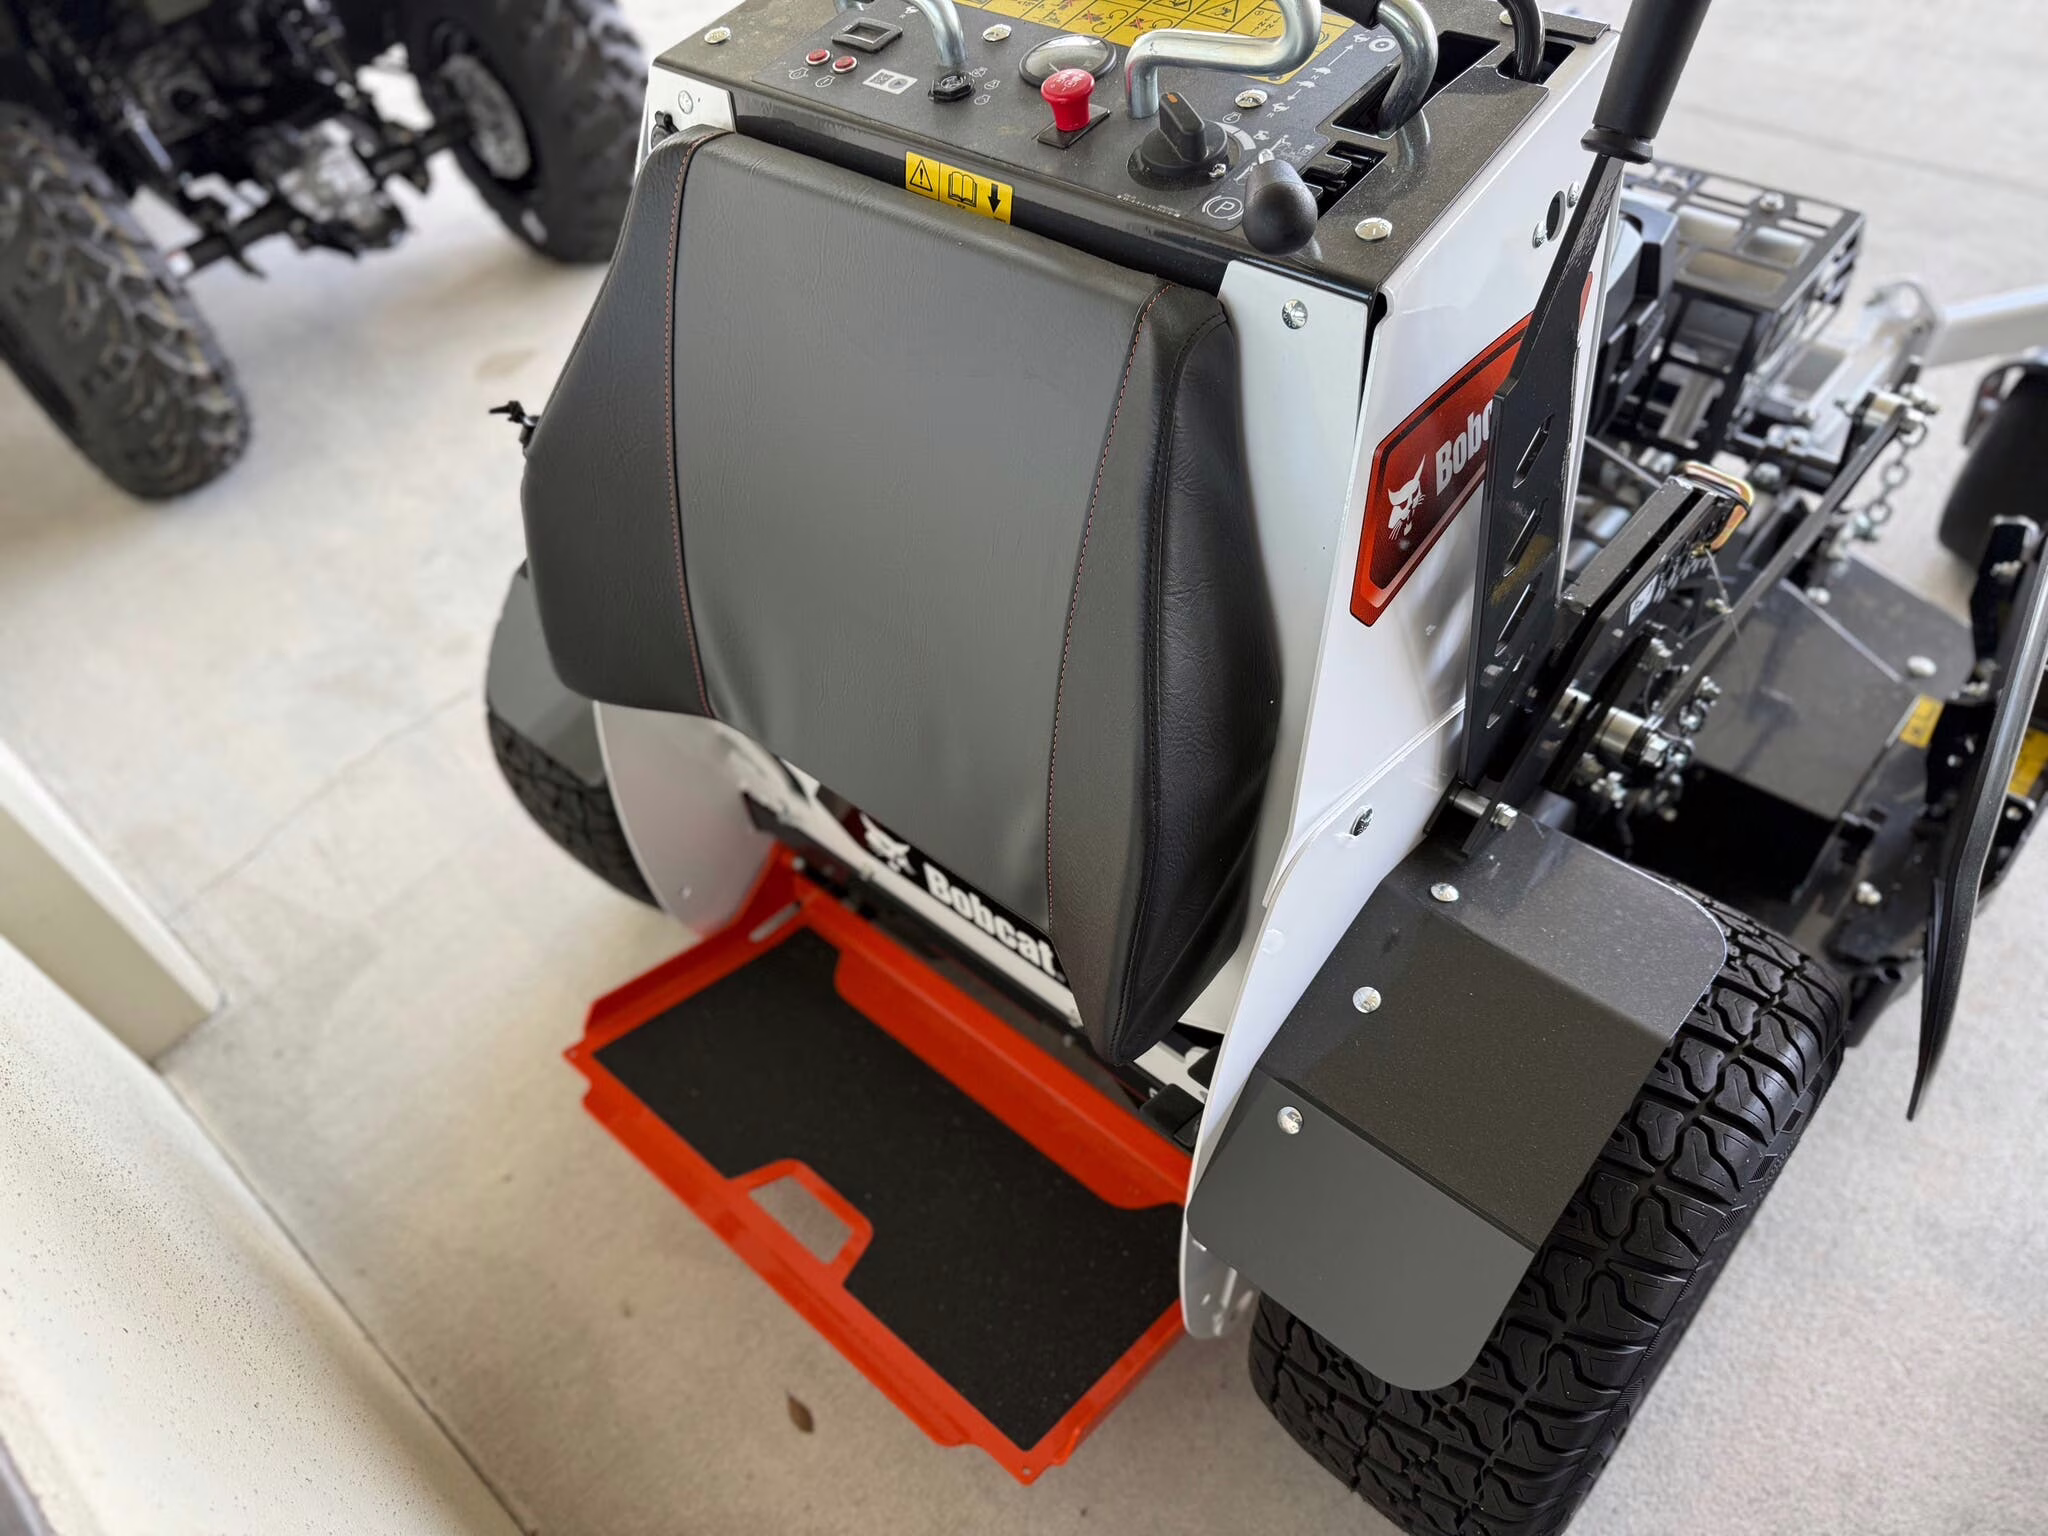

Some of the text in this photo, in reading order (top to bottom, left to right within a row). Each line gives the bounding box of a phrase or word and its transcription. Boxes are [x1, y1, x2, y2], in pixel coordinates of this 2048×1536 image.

[1214, 200, 1236, 213] P
[1435, 399, 1494, 496] Bobc
[922, 862, 1057, 977] Bobcat
